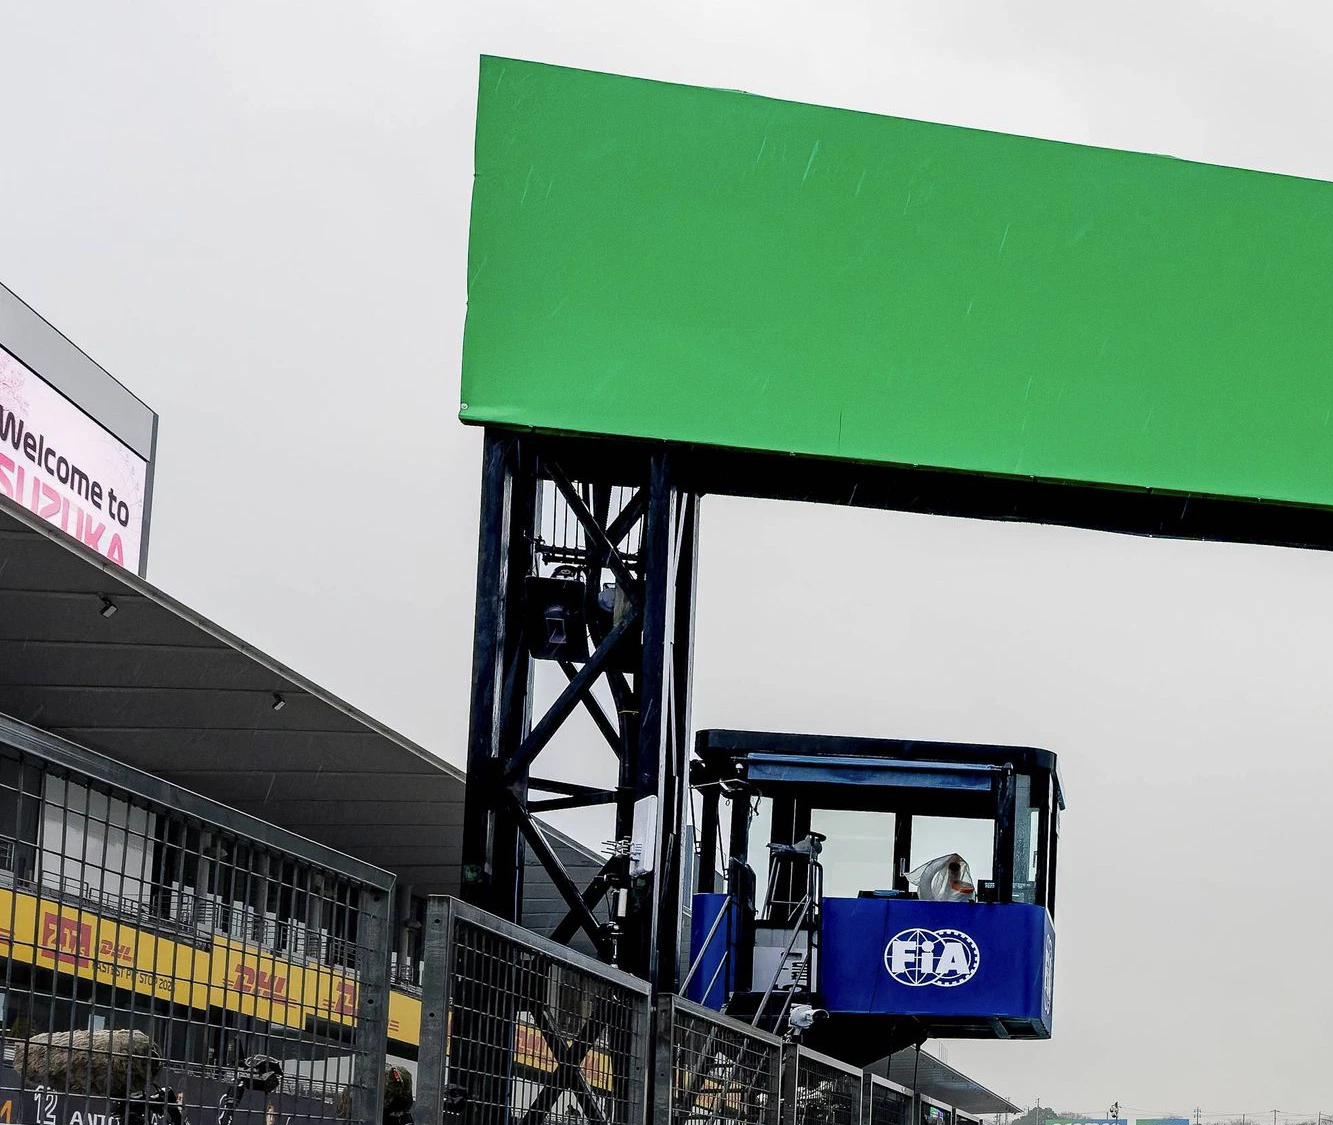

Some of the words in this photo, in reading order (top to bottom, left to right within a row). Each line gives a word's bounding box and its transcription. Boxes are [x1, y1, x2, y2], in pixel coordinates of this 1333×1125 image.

[0, 404, 103, 511] Welcome
[108, 488, 129, 527] to
[100, 939, 132, 962] DHL
[232, 963, 288, 1001] DHL
